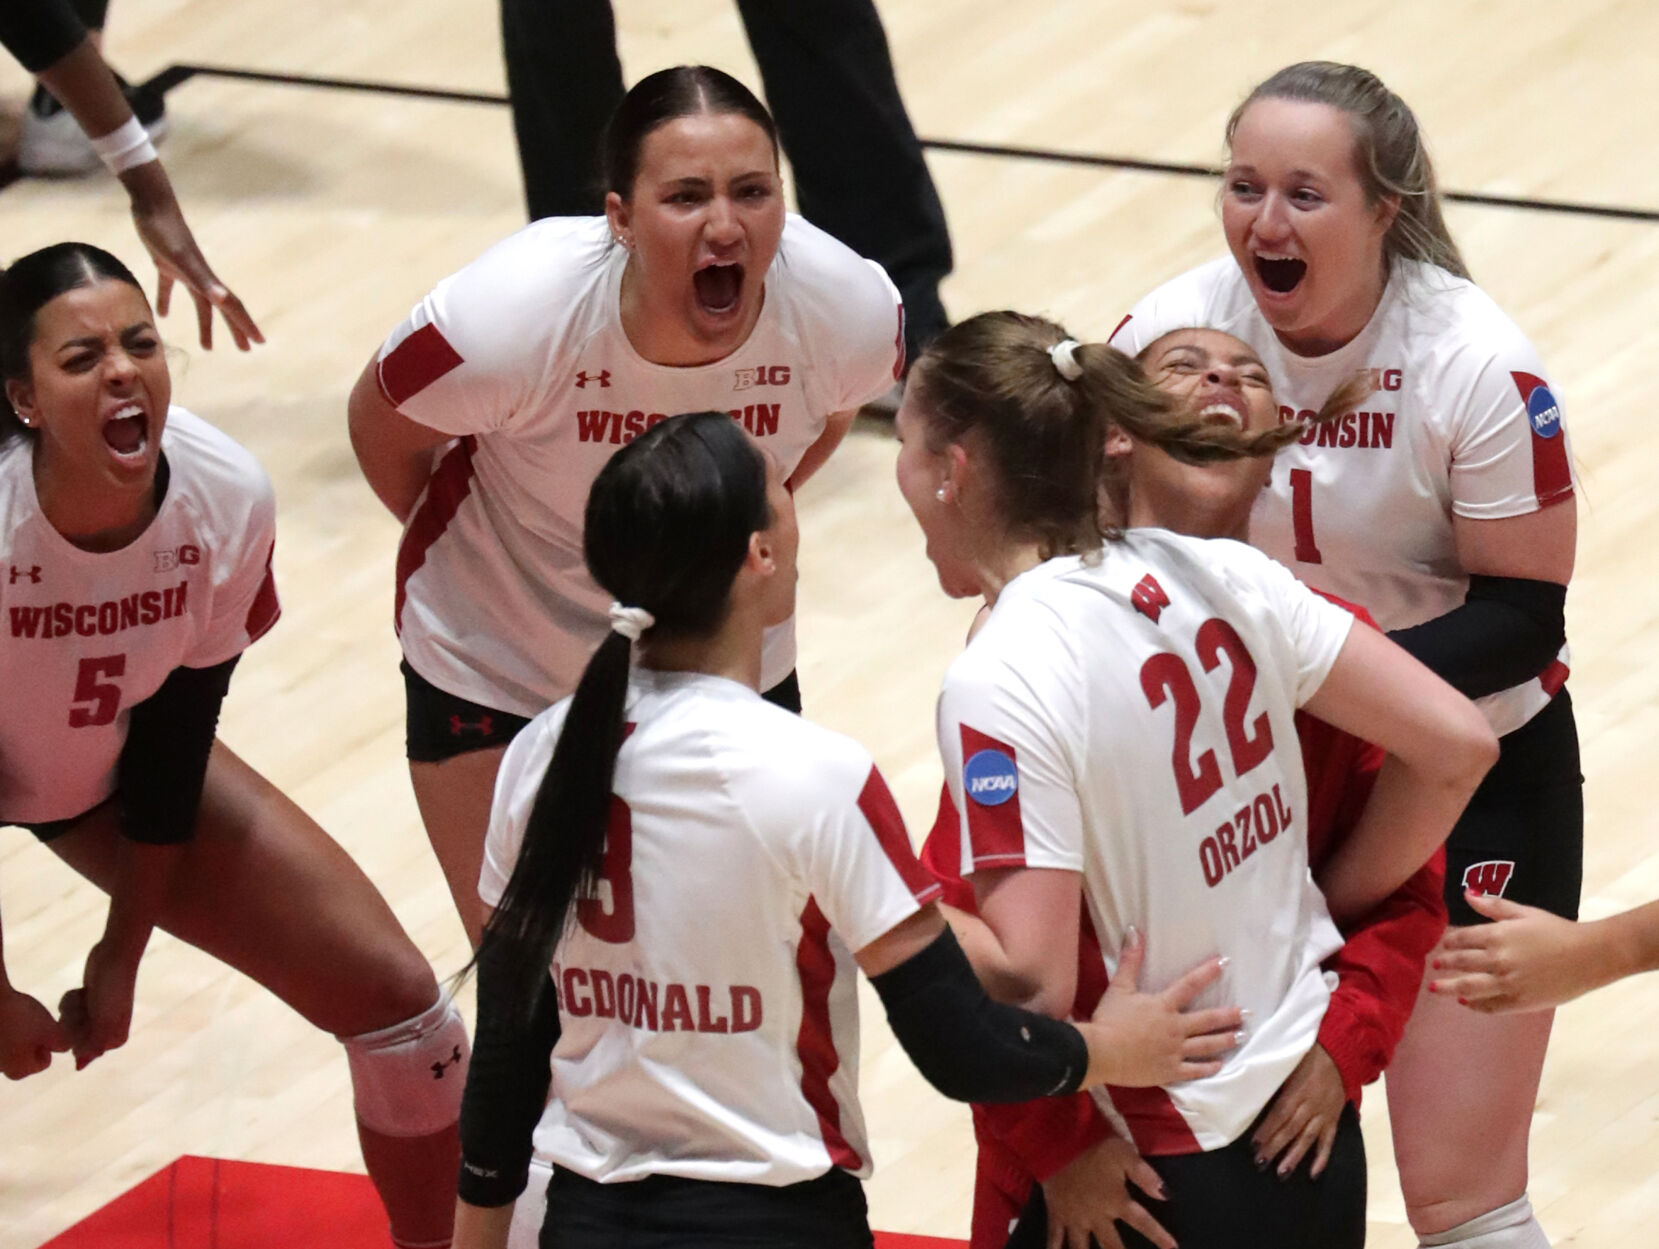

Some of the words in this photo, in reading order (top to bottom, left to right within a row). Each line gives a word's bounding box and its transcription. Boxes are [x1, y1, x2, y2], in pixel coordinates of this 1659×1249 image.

[734, 366, 791, 391] B1G
[577, 404, 781, 444] WISIN
[1535, 406, 1559, 429] NCAA
[1290, 468, 1322, 564] 1
[1130, 573, 1171, 625] W
[68, 653, 126, 728] 5
[1139, 617, 1275, 817] 22
[971, 774, 1018, 793] NCAA
[1199, 783, 1292, 888] ORZOL
[1462, 861, 1515, 897] W
[555, 961, 763, 1034] CDONALD
